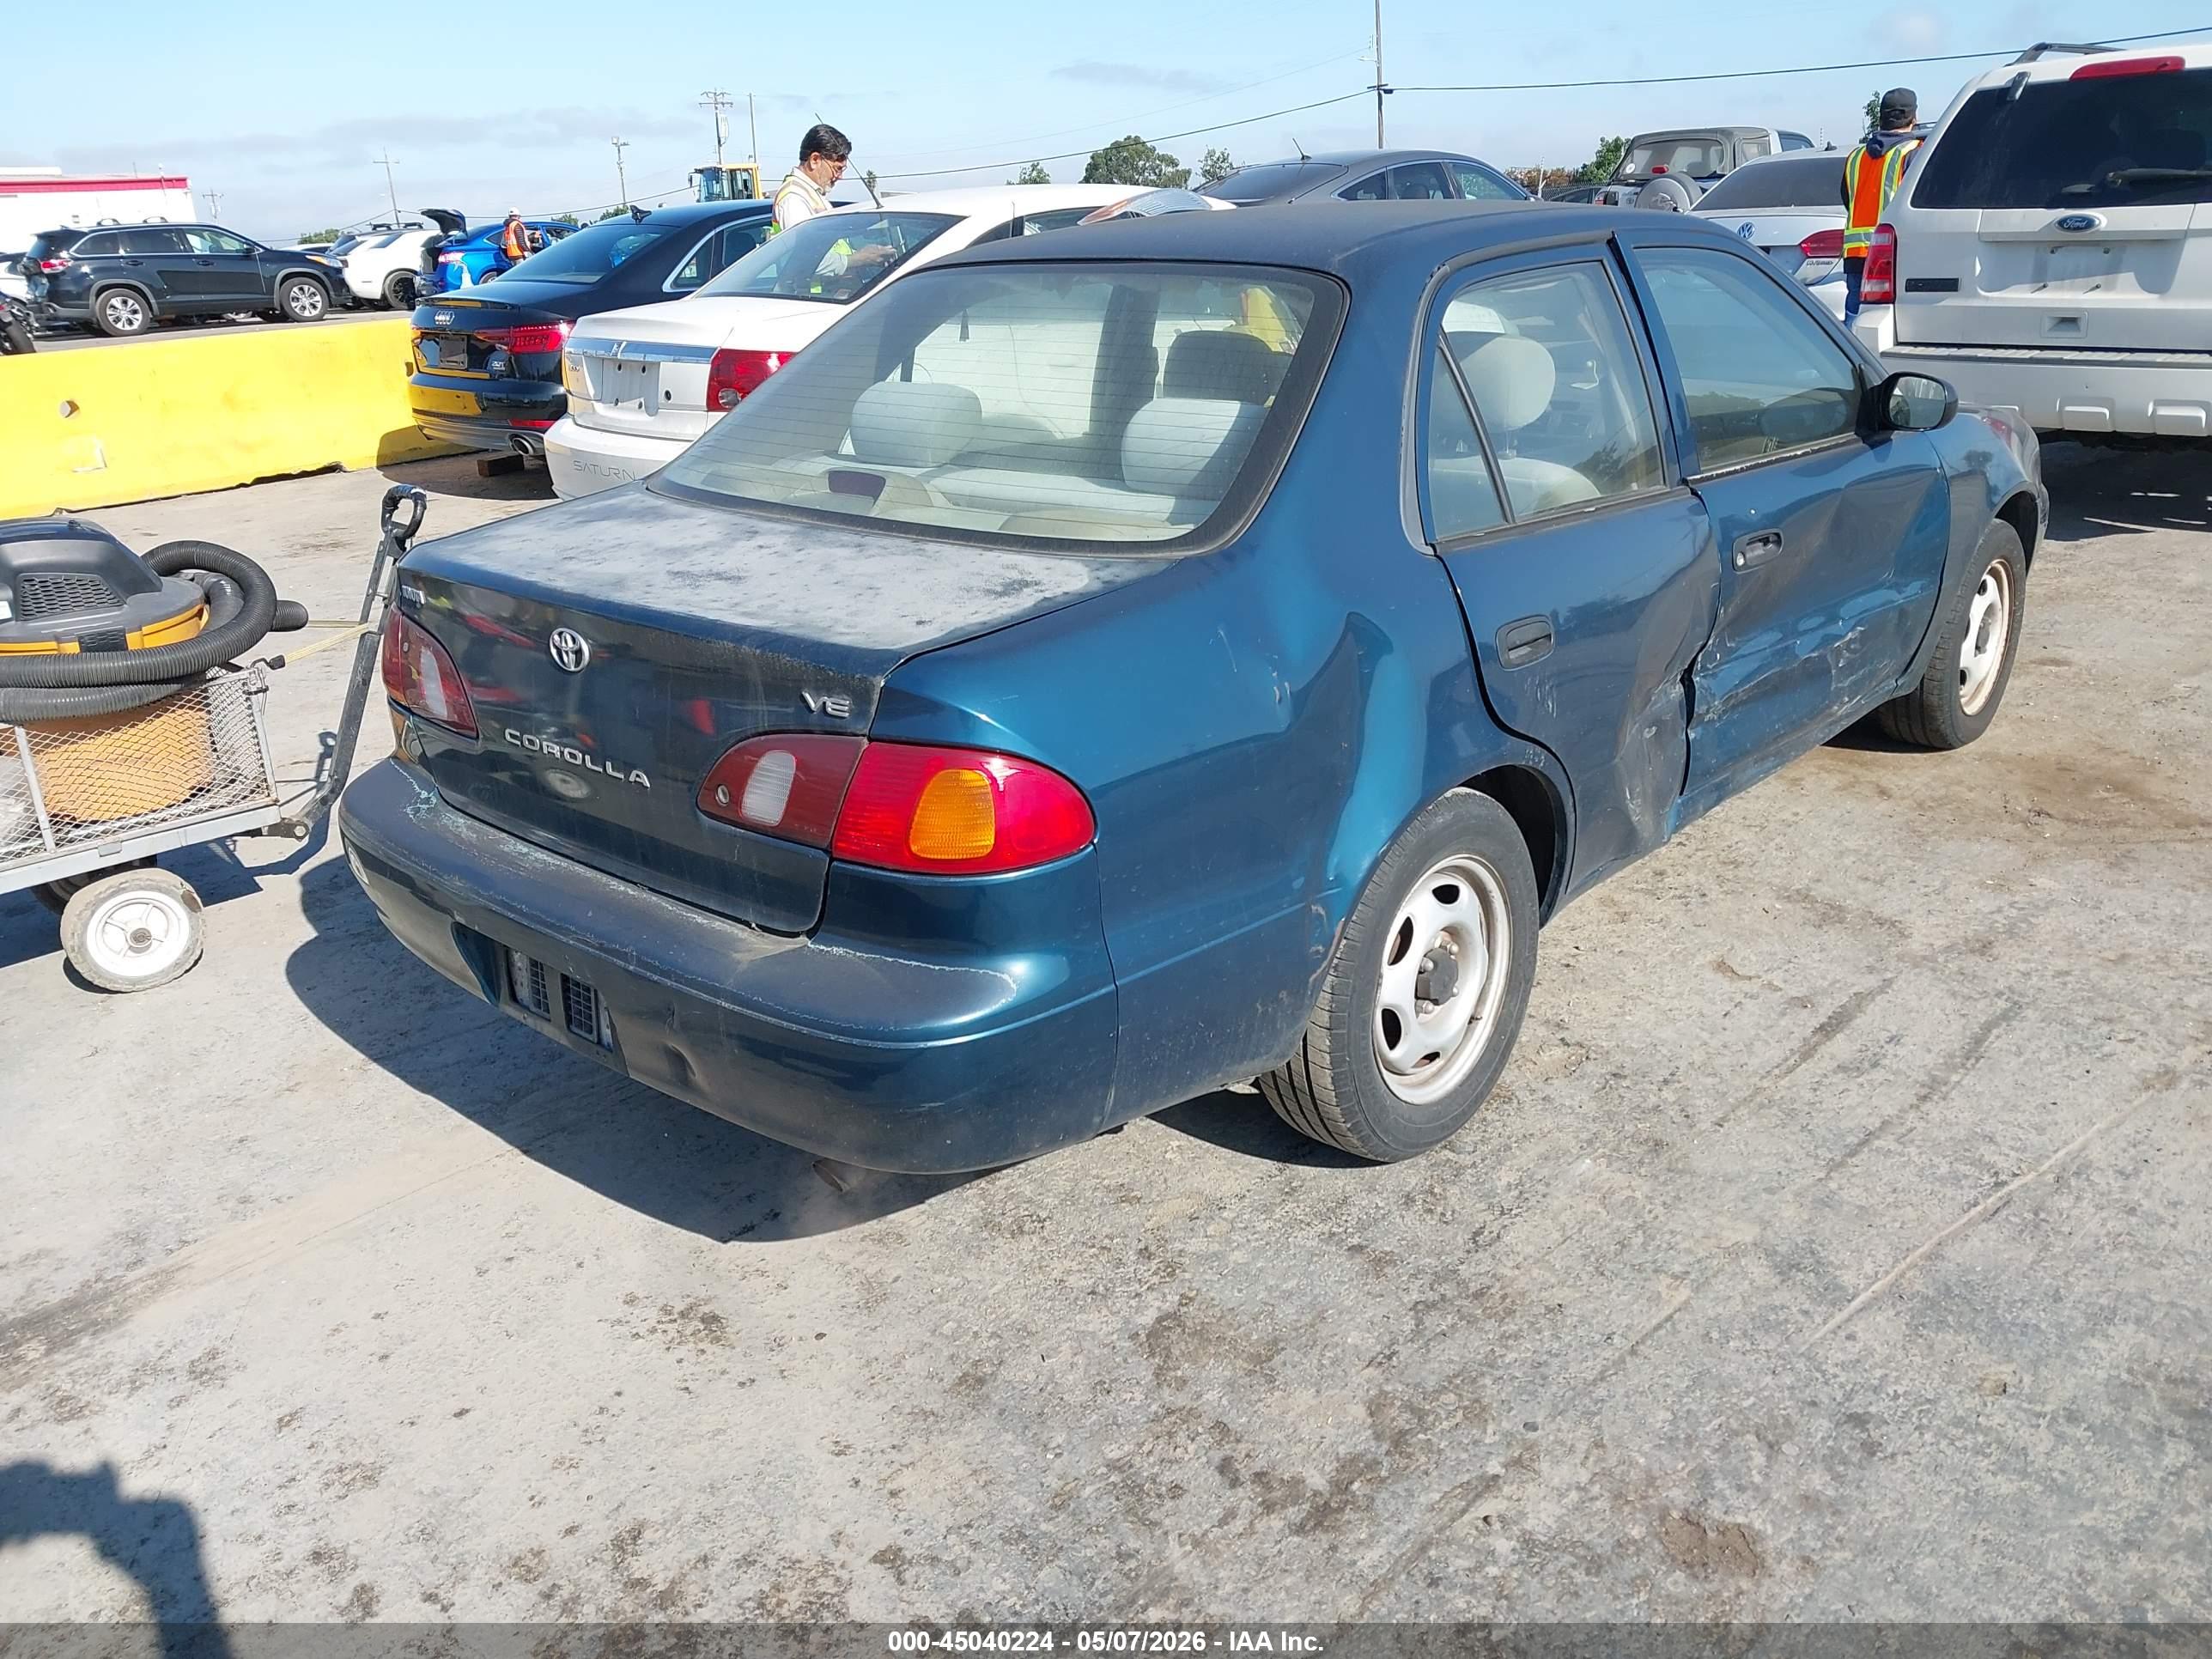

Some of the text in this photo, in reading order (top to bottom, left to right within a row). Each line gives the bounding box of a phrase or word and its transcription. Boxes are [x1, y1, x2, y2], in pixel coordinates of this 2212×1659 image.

[573, 459, 637, 481] SATURN
[801, 690, 851, 718] VE
[504, 728, 651, 788] COROLLA
